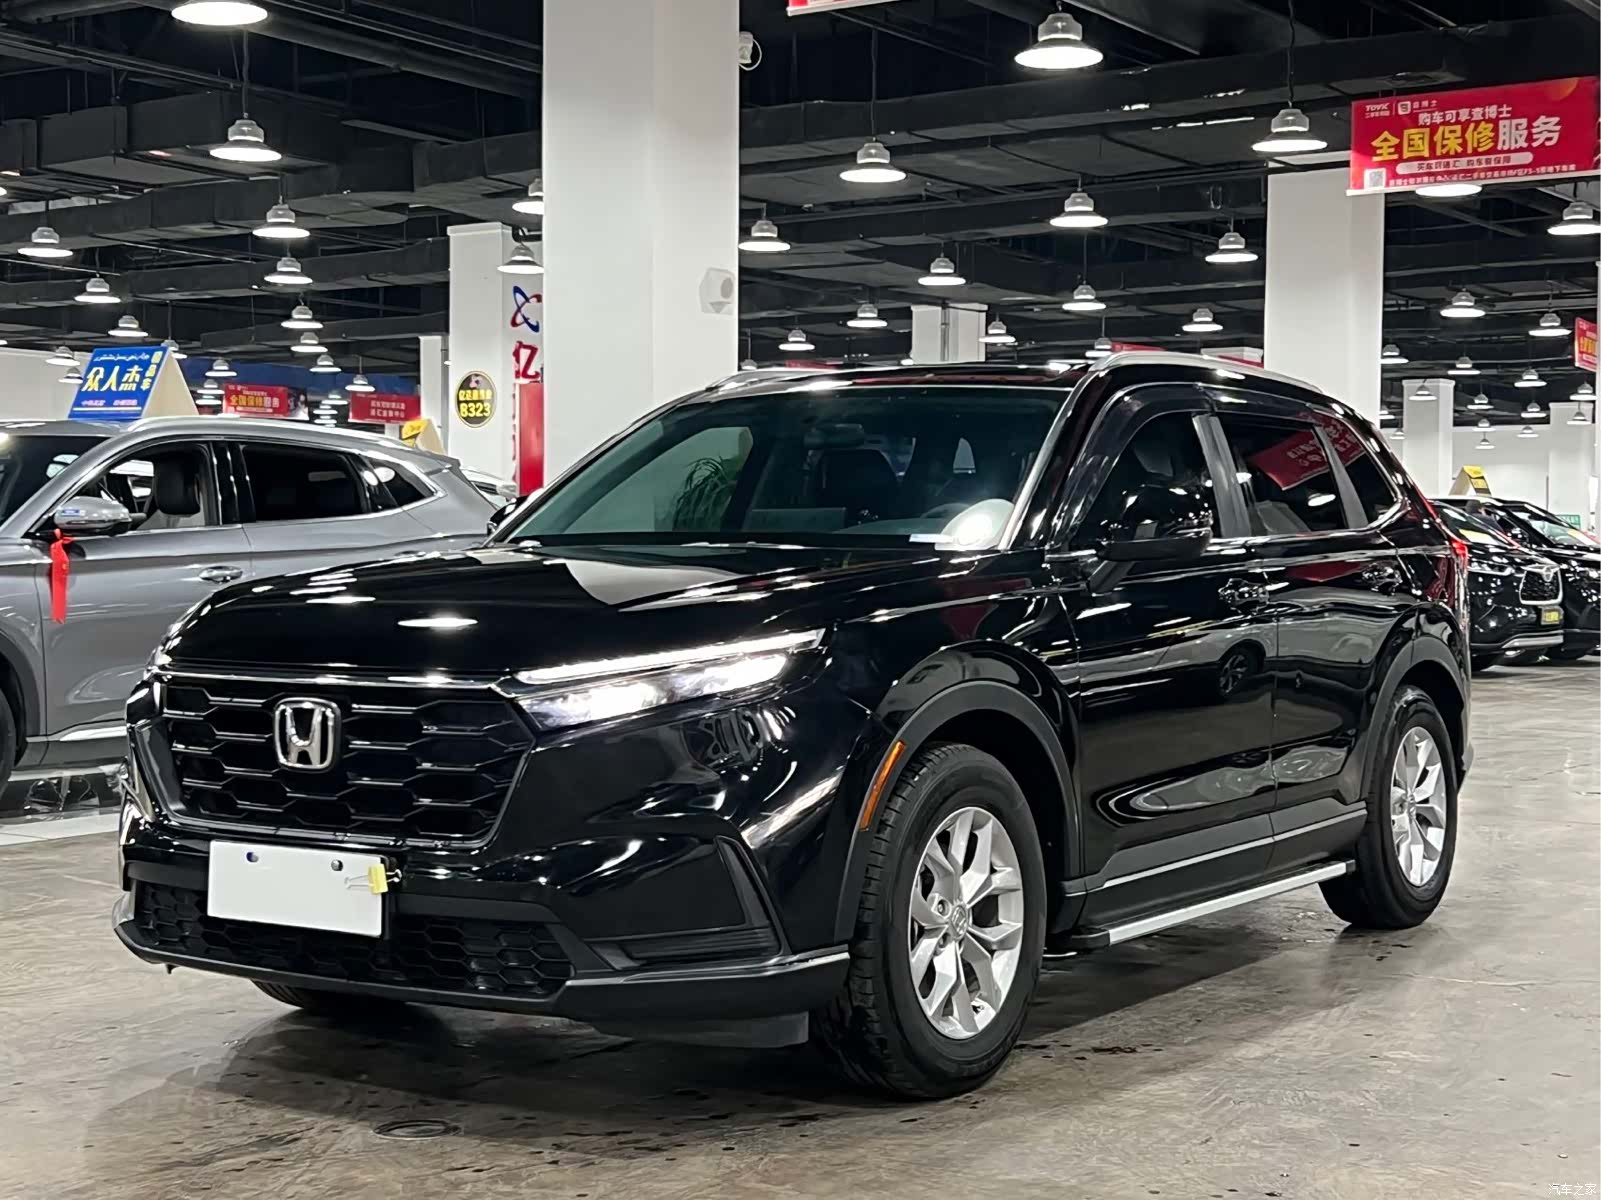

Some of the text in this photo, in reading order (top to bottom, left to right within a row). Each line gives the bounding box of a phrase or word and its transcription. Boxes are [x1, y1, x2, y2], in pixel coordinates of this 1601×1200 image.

[1418, 104, 1512, 126] 购车可享查博士
[1371, 115, 1562, 162] 全国保修服务
[512, 341, 541, 379] 亿
[81, 365, 143, 391] 众人杰
[460, 402, 491, 417] 8323
